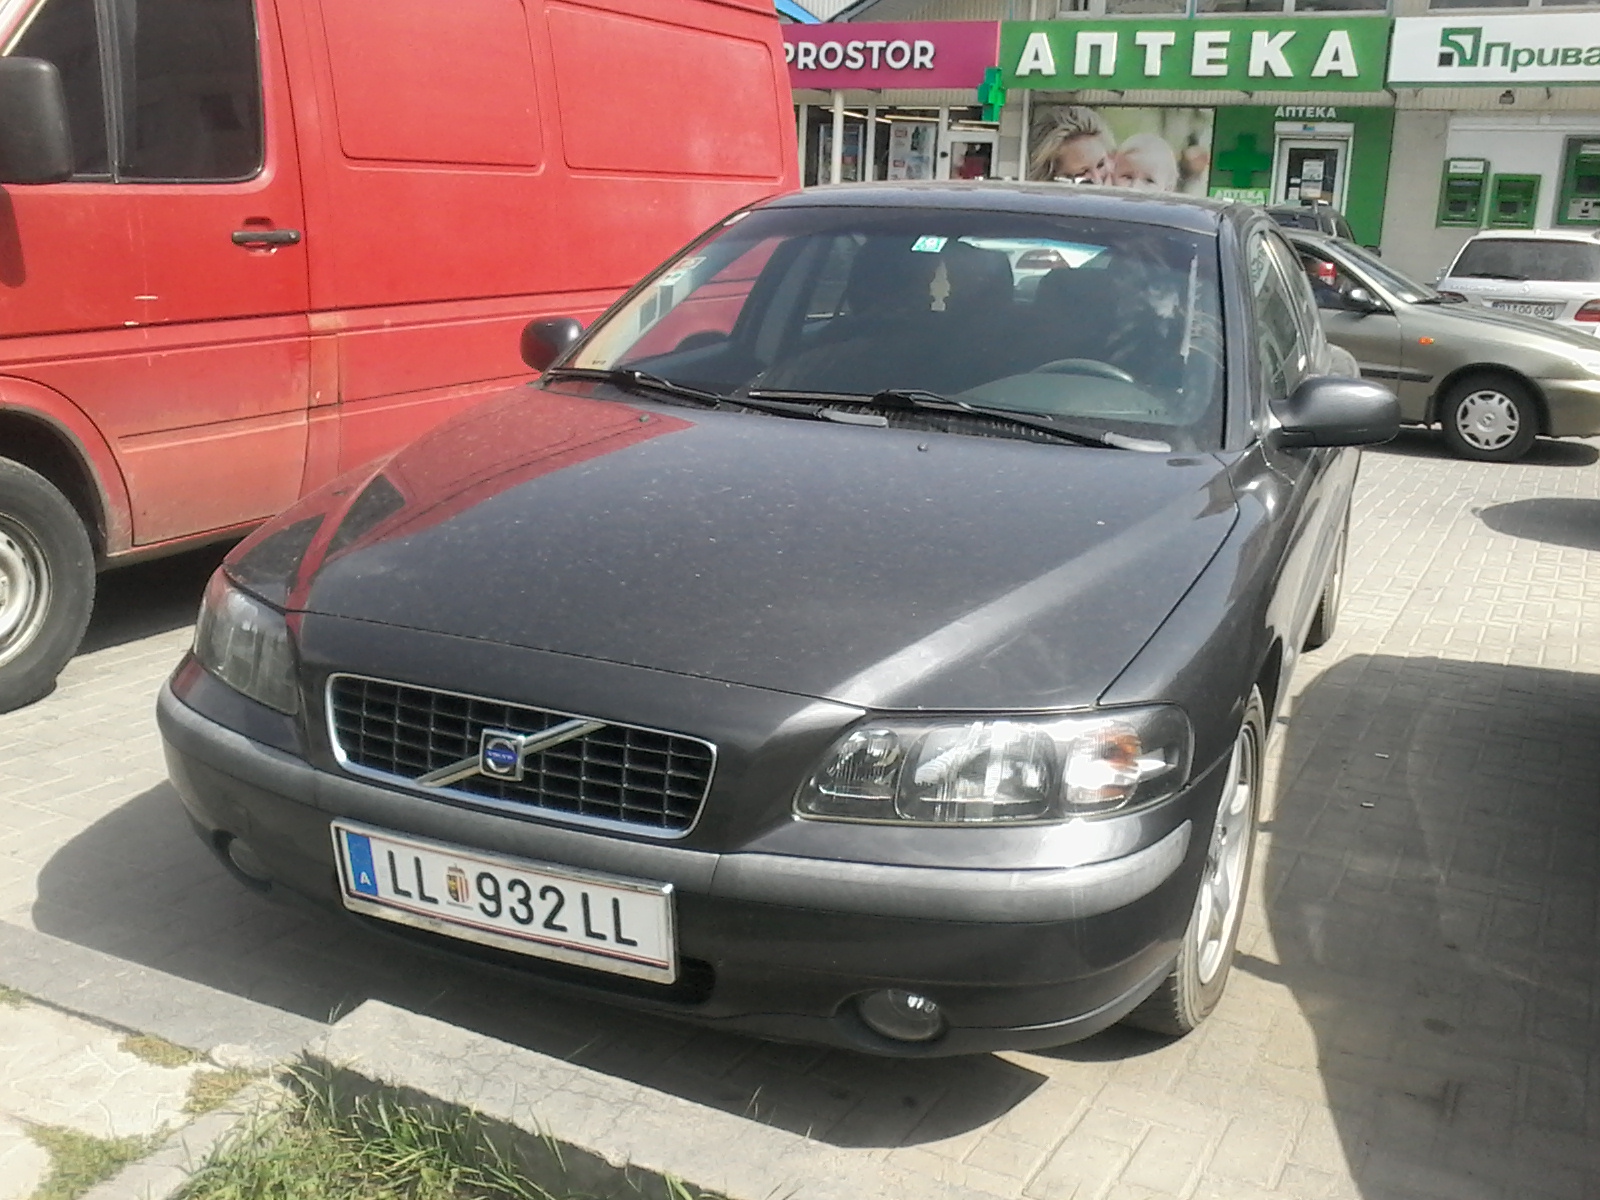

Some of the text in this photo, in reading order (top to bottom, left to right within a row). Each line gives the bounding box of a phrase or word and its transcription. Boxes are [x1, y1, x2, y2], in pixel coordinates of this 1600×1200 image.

[1015, 30, 1359, 78] АПТЕКА
[1482, 42, 1600, 73] Прива
[1274, 105, 1337, 118] АПТЕКА
[359, 871, 371, 886] A
[387, 850, 638, 946] LL 932 LL
